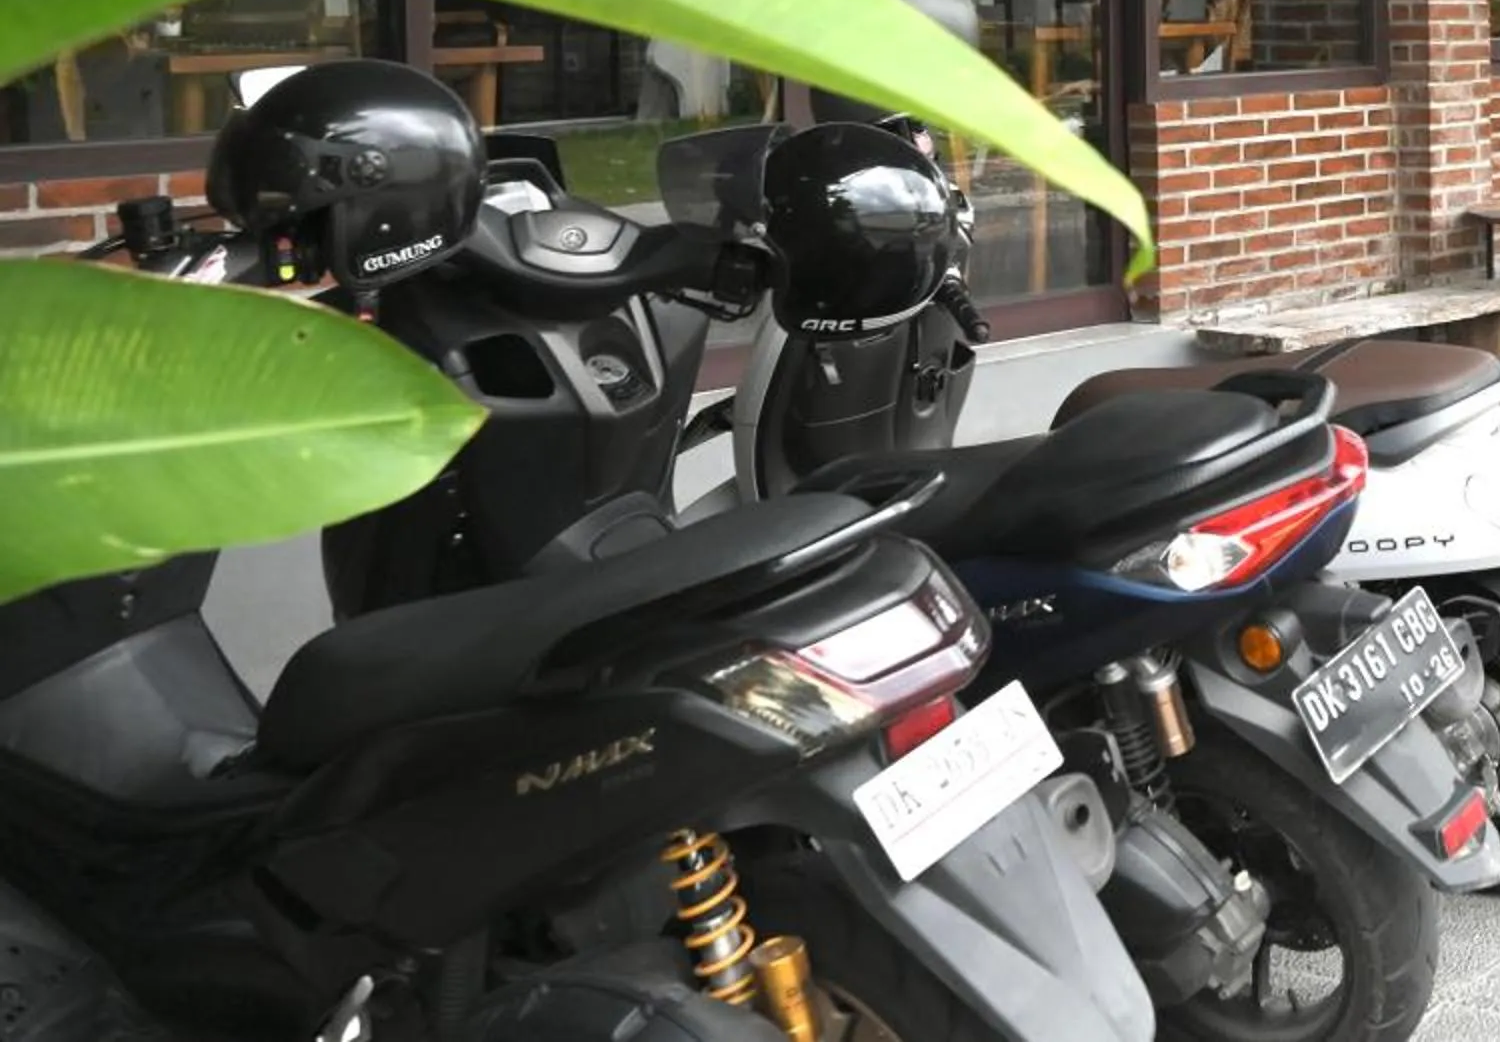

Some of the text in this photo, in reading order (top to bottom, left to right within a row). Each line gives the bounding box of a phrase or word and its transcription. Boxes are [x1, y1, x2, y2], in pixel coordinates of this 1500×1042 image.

[1348, 535, 1455, 553] OOPY
[1303, 600, 1438, 733] DK 3161 CBC
